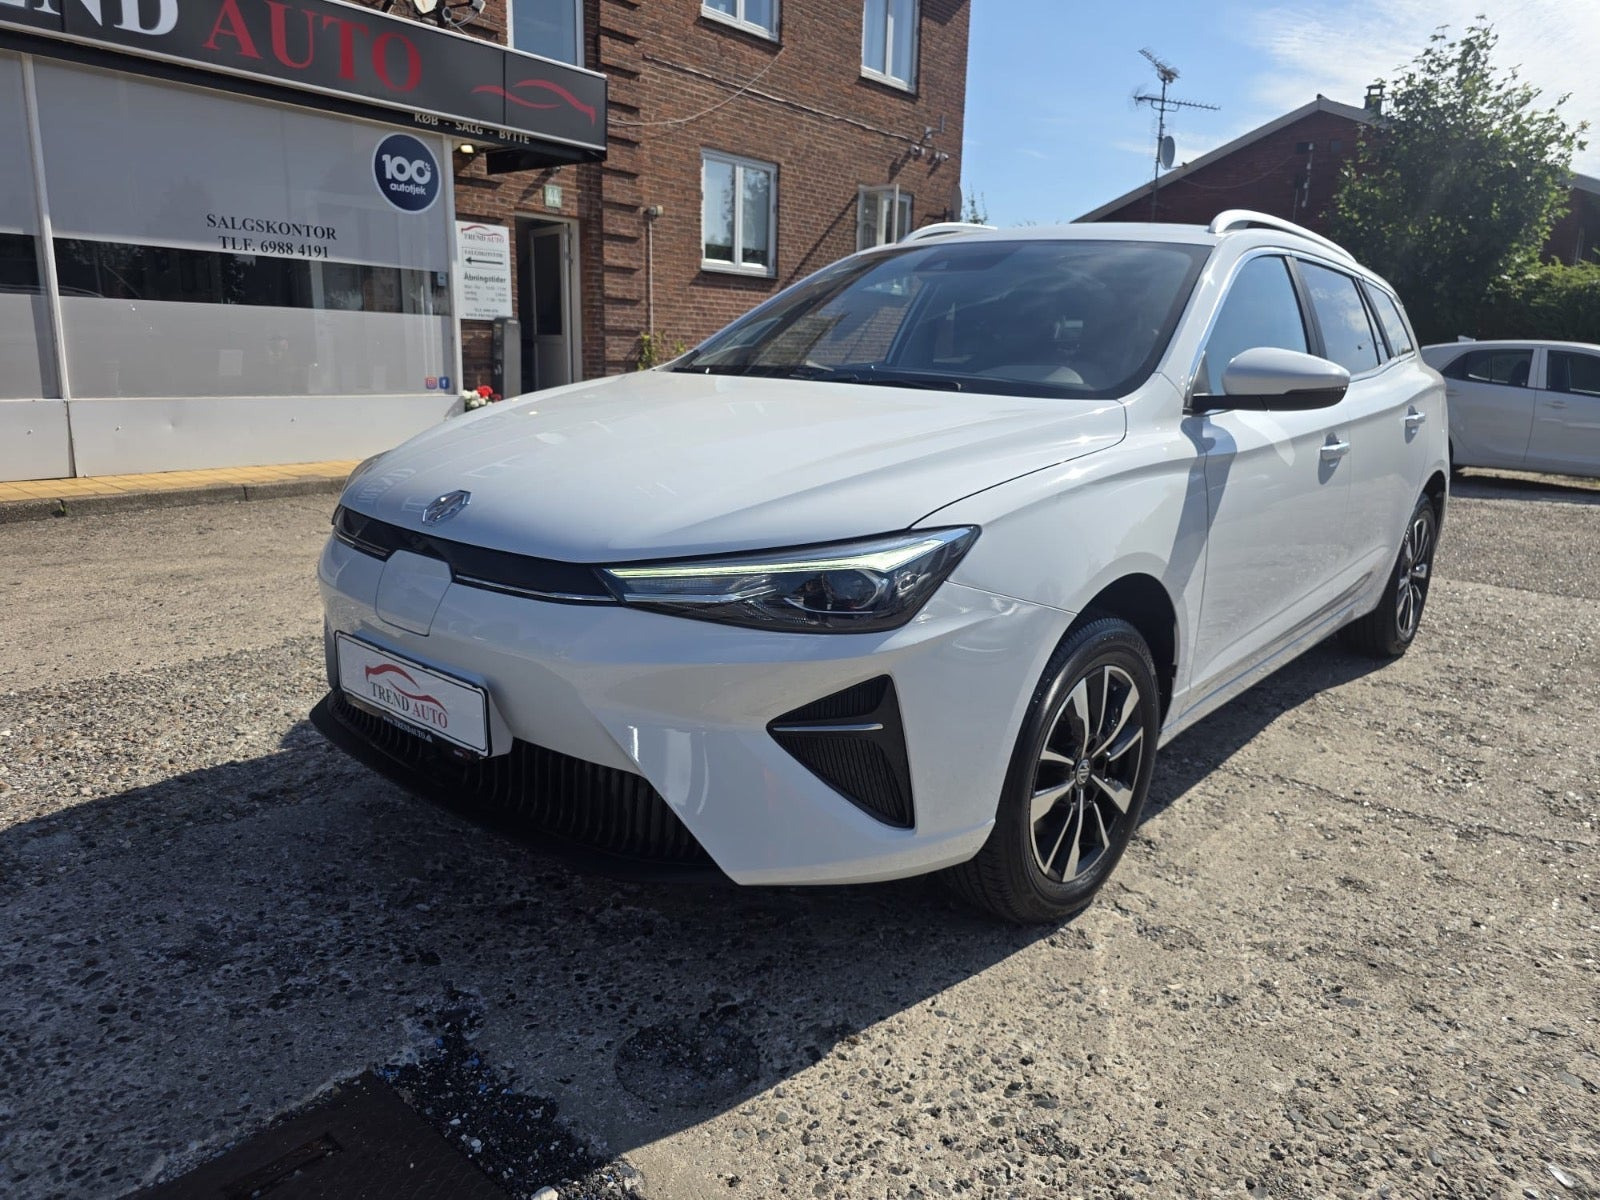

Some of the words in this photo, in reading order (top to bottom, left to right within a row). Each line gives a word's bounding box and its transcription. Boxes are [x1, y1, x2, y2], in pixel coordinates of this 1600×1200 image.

[203, 0, 422, 93] AUTO
[414, 112, 439, 126] KØB
[455, 121, 484, 135] SALG
[499, 130, 531, 145] BYTTE
[390, 183, 426, 195] autotjek
[206, 213, 337, 240] SALGSKONTOR
[218, 235, 256, 252] TLF.
[260, 240, 294, 255] 6988
[298, 244, 329, 258] 4191
[370, 681, 410, 712] TREND
[412, 702, 448, 729] AUTO
